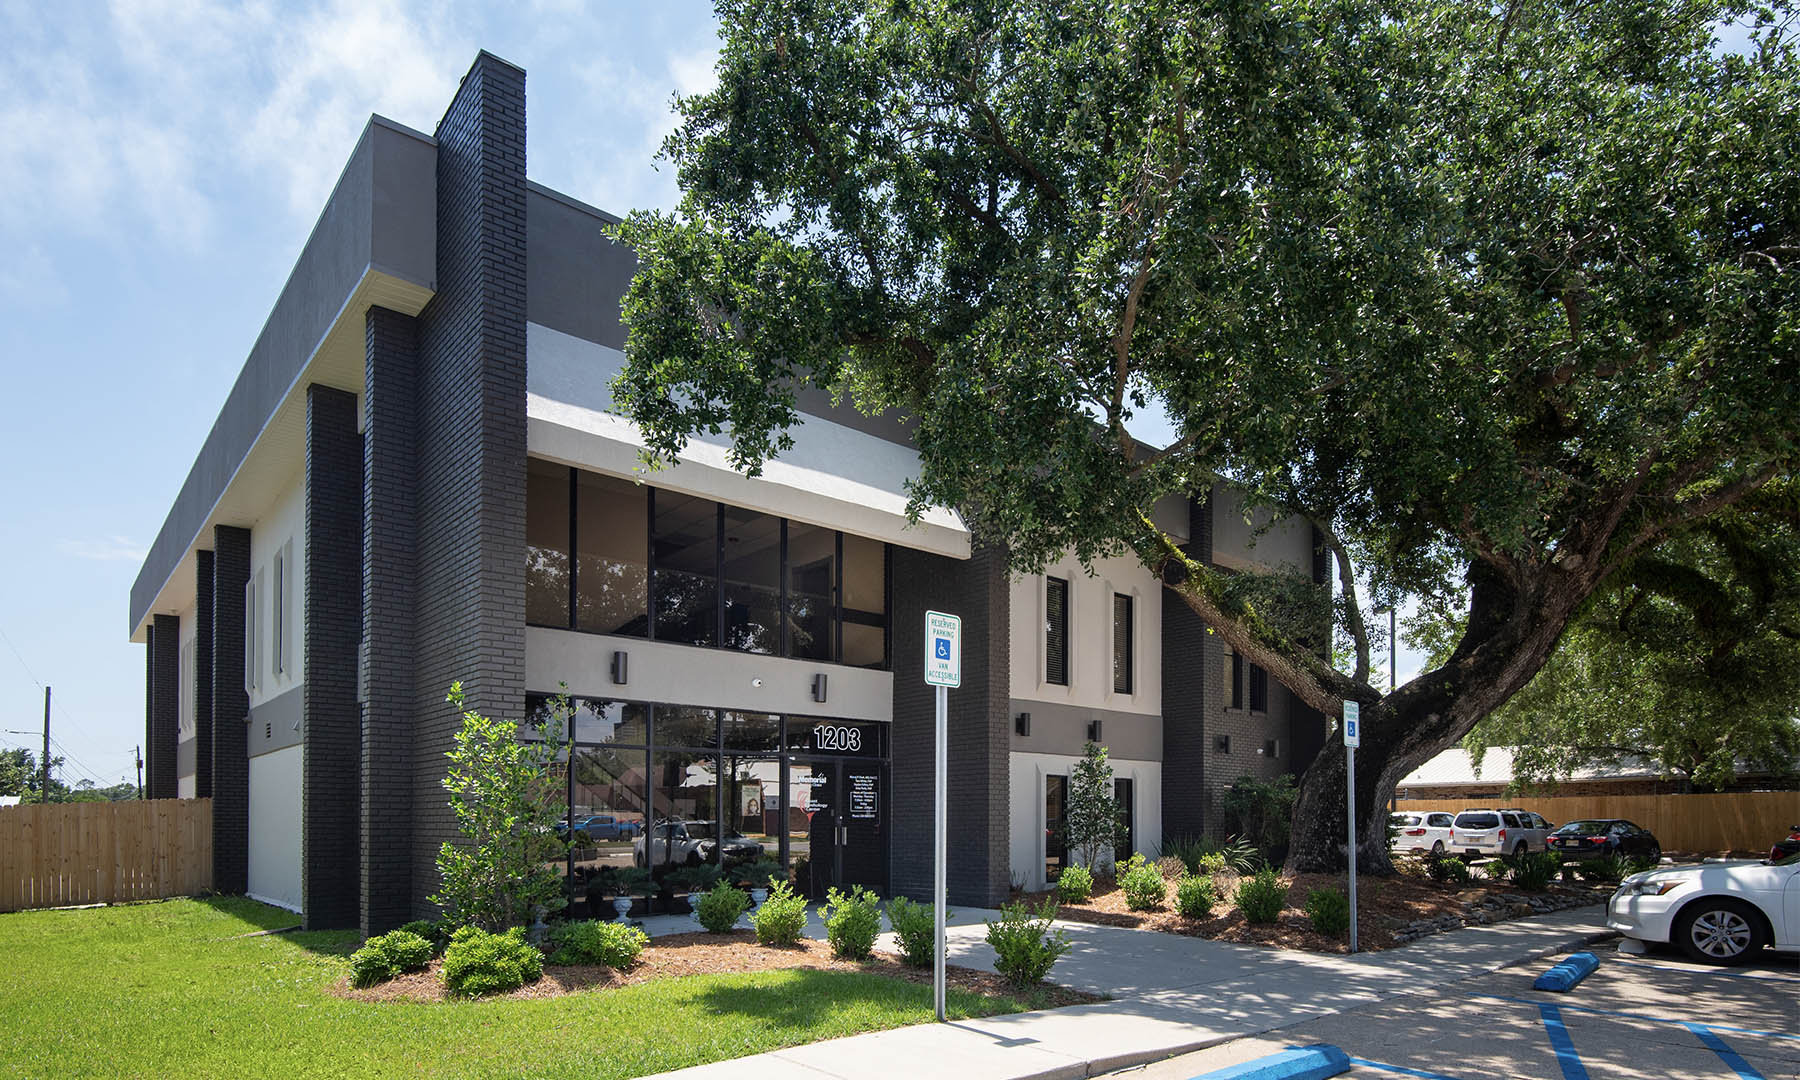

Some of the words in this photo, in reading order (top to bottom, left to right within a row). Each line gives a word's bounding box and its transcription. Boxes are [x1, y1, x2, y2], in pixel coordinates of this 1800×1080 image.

[931, 618, 956, 630] RESERVED
[933, 628, 954, 639] PARKING
[929, 670, 957, 681] ACCESSIBLE
[814, 725, 861, 751] 1203
[798, 775, 826, 784] Memorial
